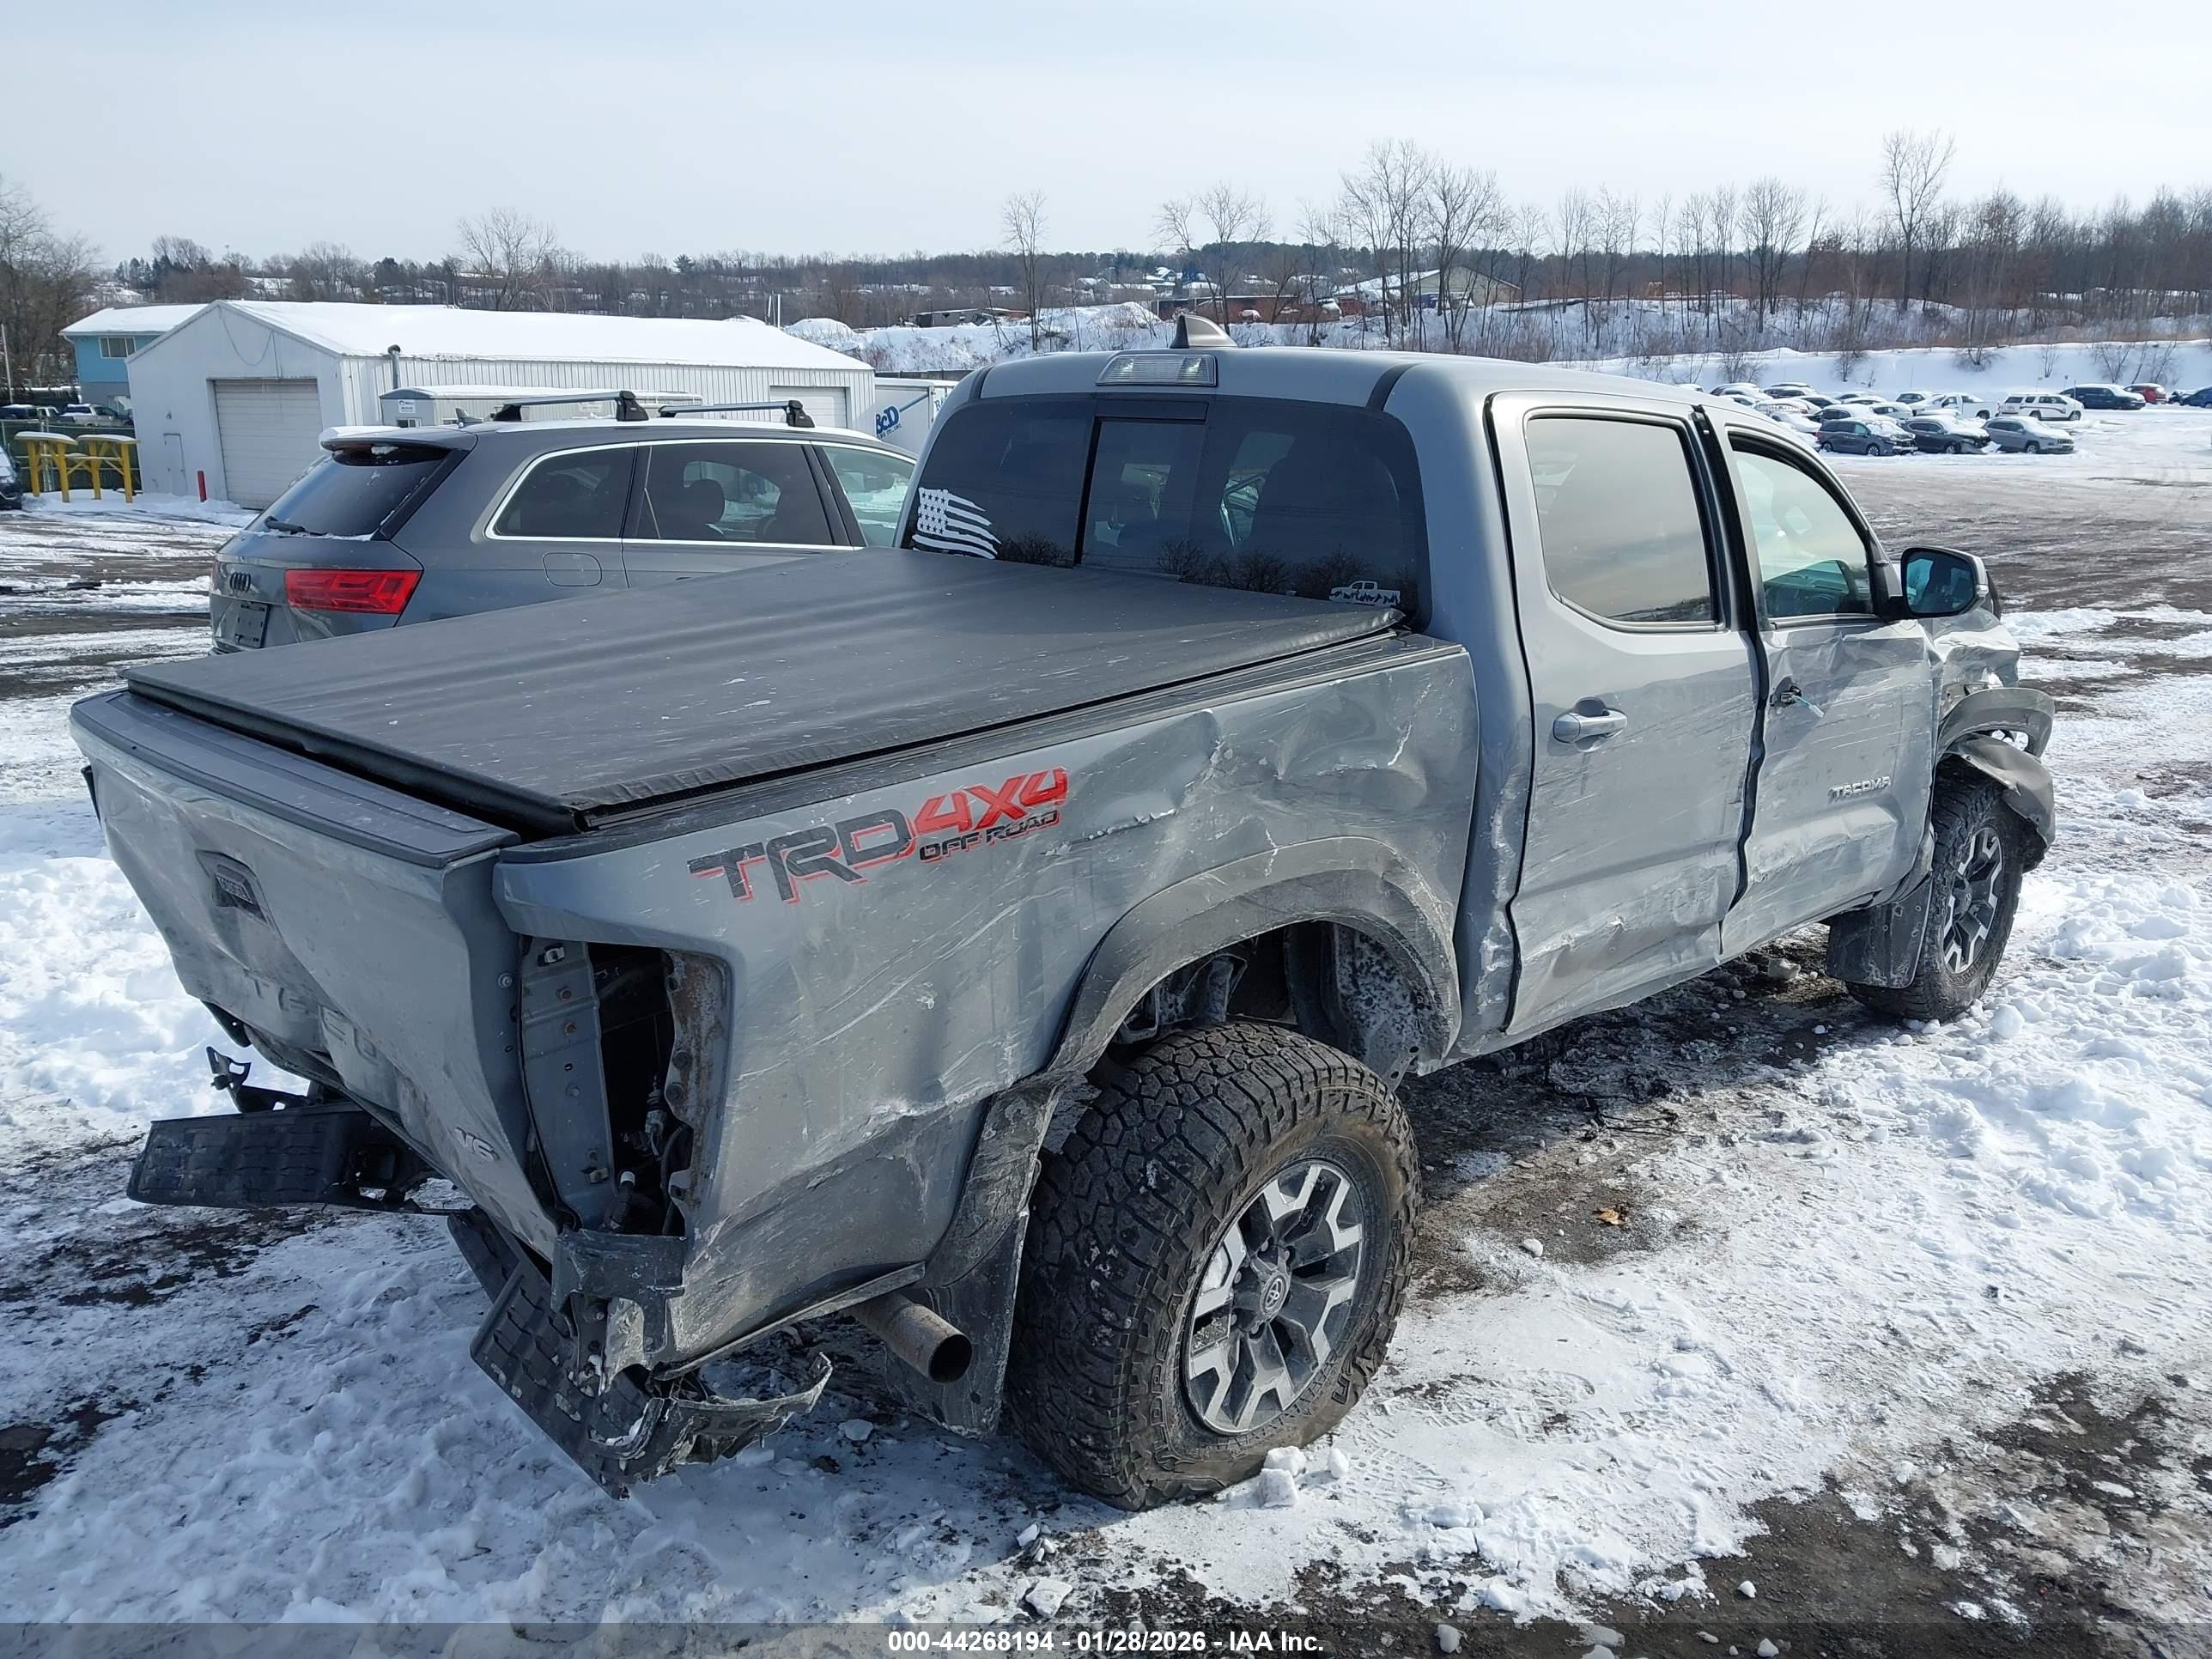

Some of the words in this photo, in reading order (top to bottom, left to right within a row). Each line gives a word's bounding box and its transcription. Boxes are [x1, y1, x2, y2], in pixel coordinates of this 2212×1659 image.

[1830, 775, 1892, 798] TACOMA
[687, 808, 916, 904] TRD
[918, 830, 981, 863] OFF
[985, 809, 1060, 848] ROAD
[453, 1126, 497, 1163] V6
